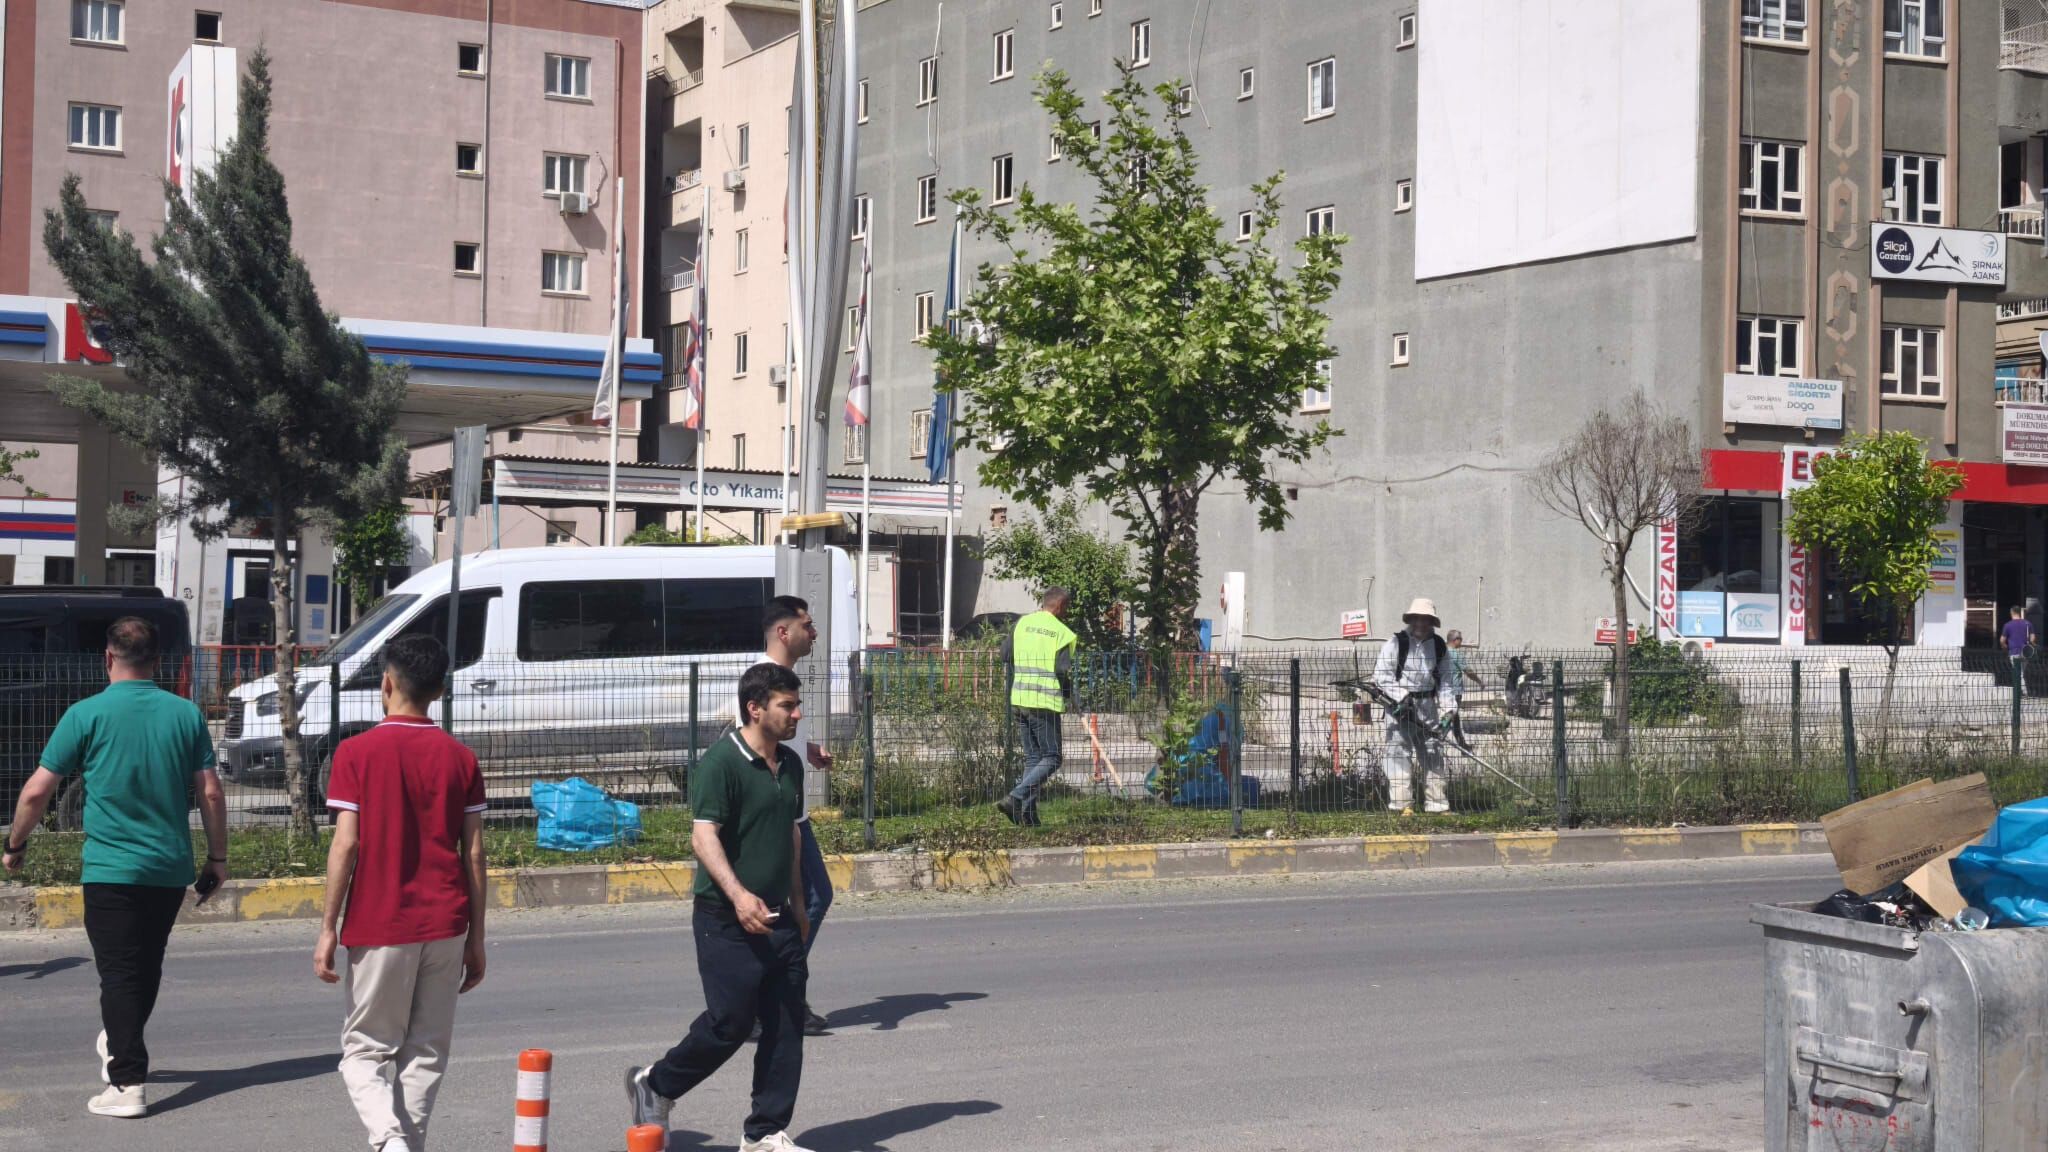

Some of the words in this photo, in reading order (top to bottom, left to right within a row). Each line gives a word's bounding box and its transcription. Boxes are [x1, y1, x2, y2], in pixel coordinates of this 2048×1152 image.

[1880, 252, 1911, 261] Gazetesi
[1972, 271, 2000, 280] AJANS
[1788, 382, 1837, 391] ANADOLU
[690, 480, 719, 496] Oto
[1659, 516, 1676, 628] ECZANE
[1789, 540, 1805, 632] ECZAN
[1736, 612, 1764, 628] SGK
